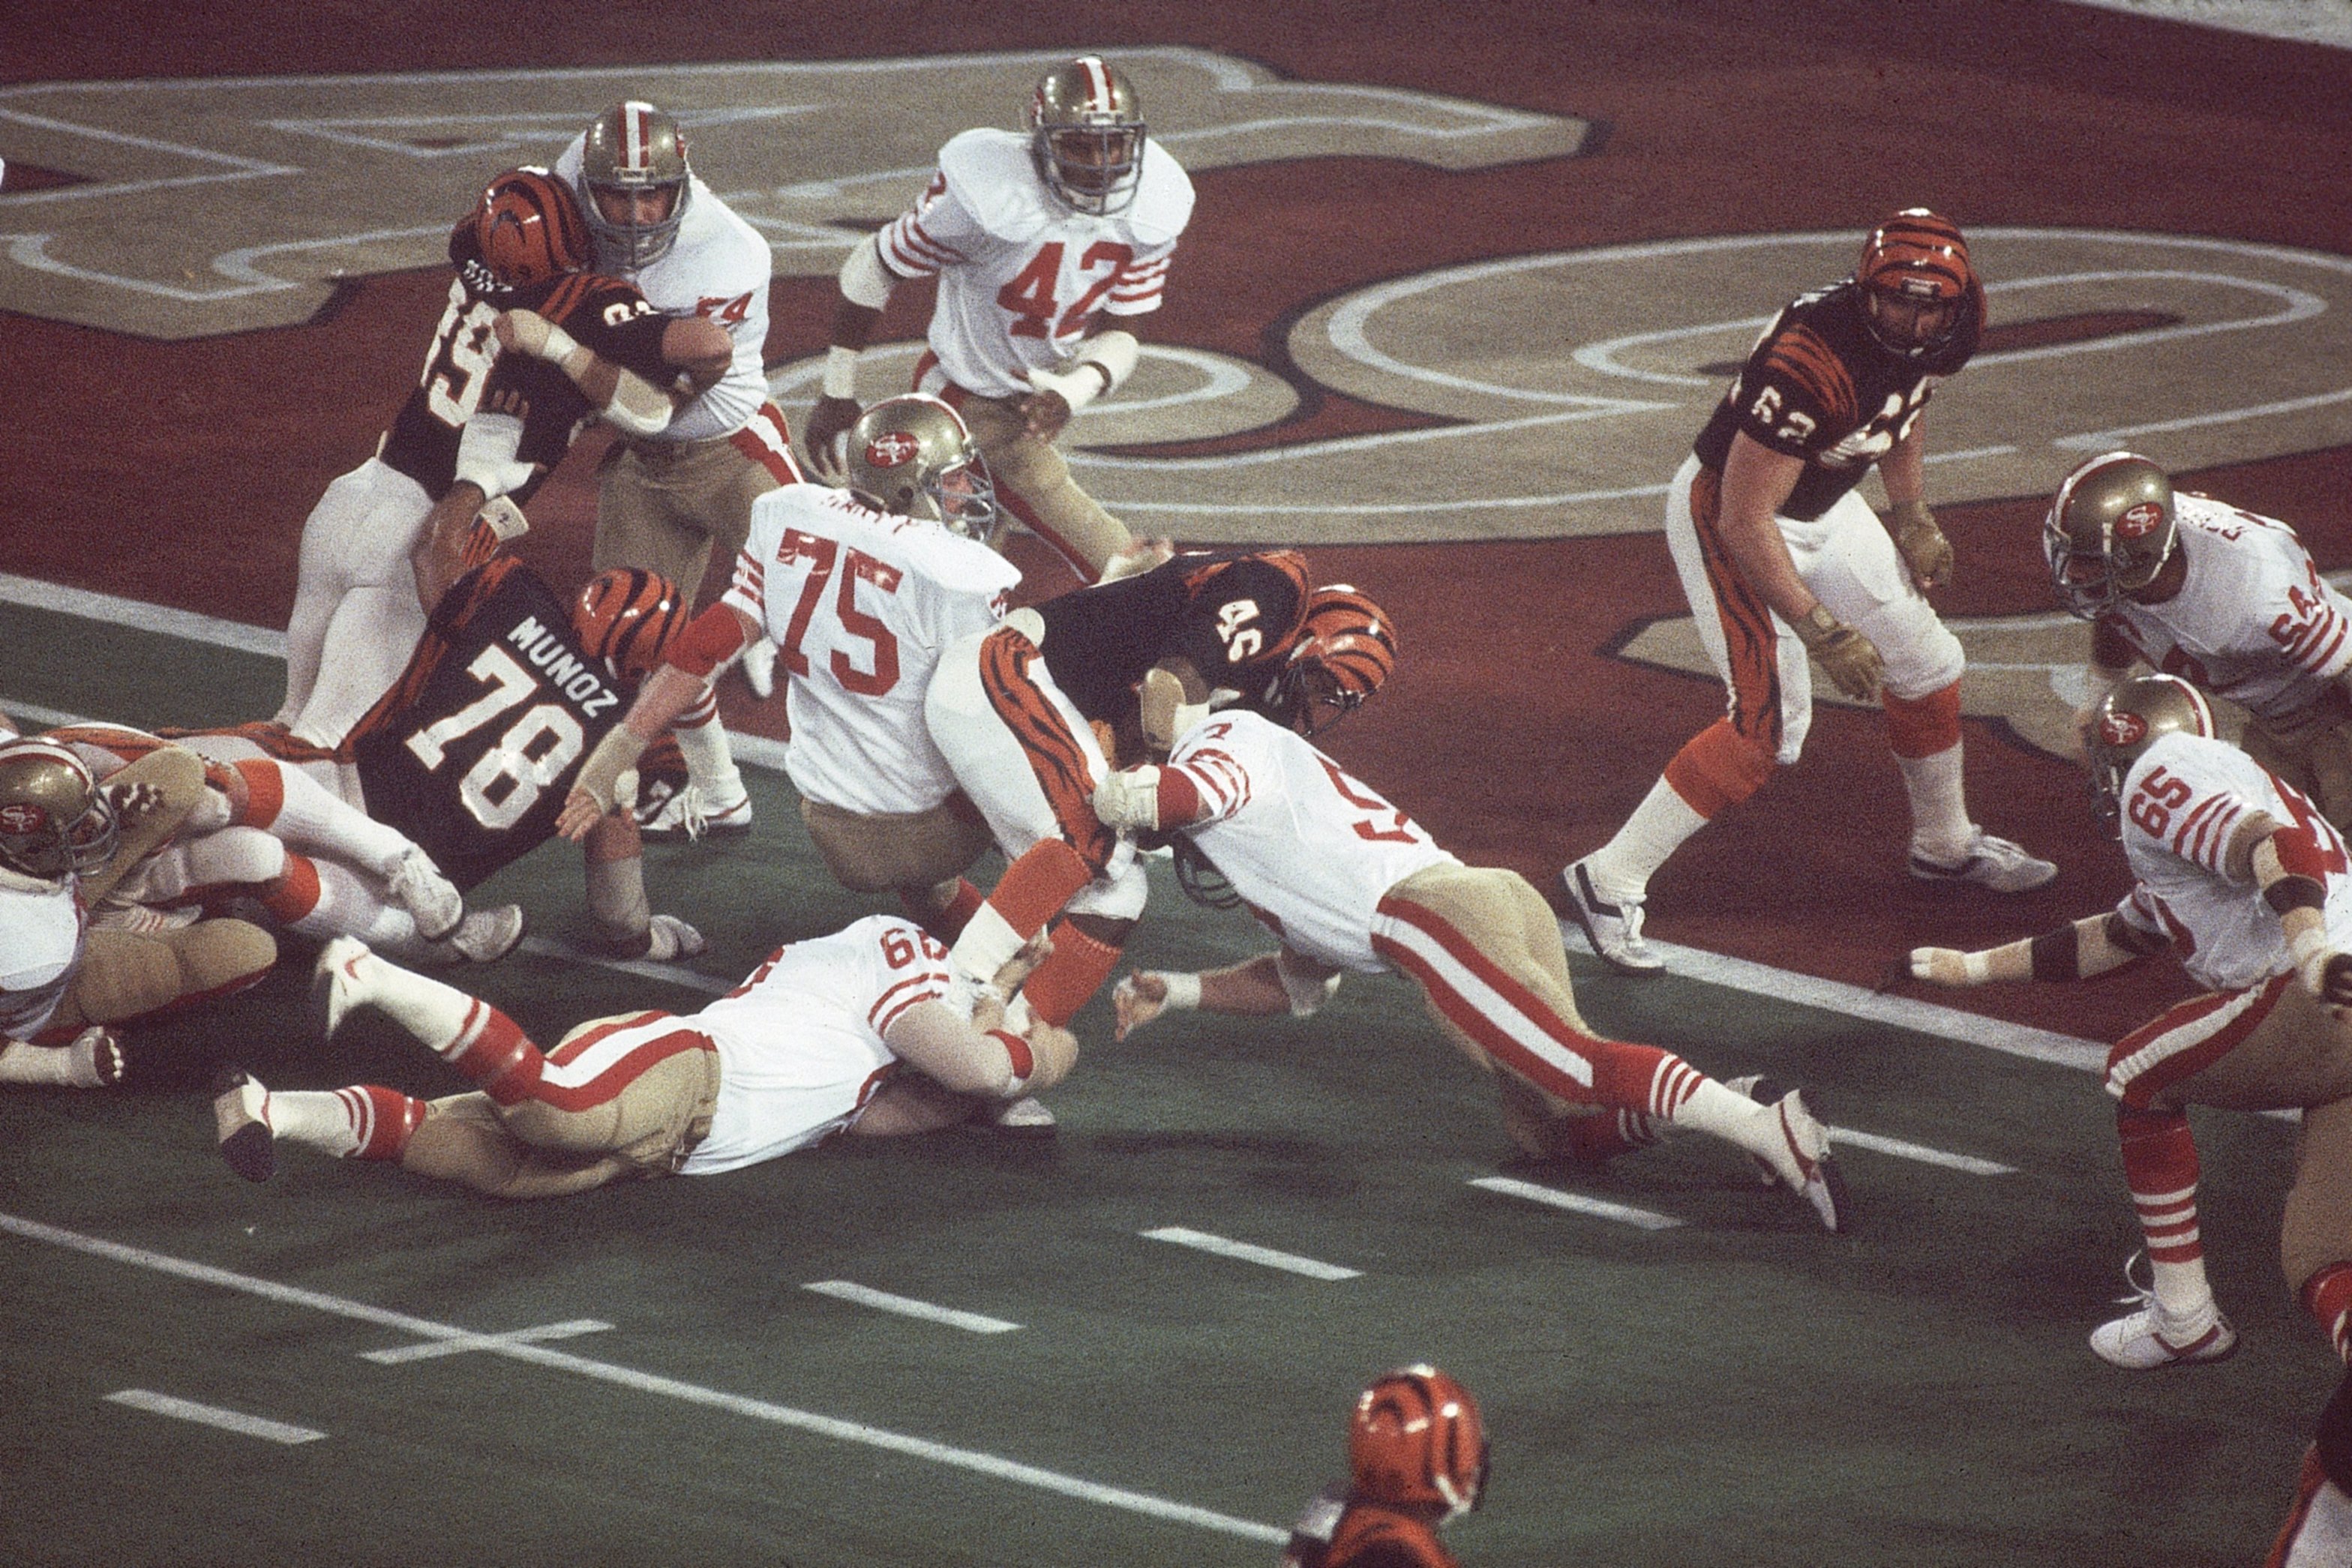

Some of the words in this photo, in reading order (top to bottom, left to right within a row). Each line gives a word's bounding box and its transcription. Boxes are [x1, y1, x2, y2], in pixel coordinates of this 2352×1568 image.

[997, 241, 1132, 339] 42
[1751, 385, 1816, 444] 62
[776, 527, 904, 697] 75
[507, 616, 619, 718] MUNOZ
[406, 643, 584, 829] 78
[2128, 765, 2193, 840] 65
